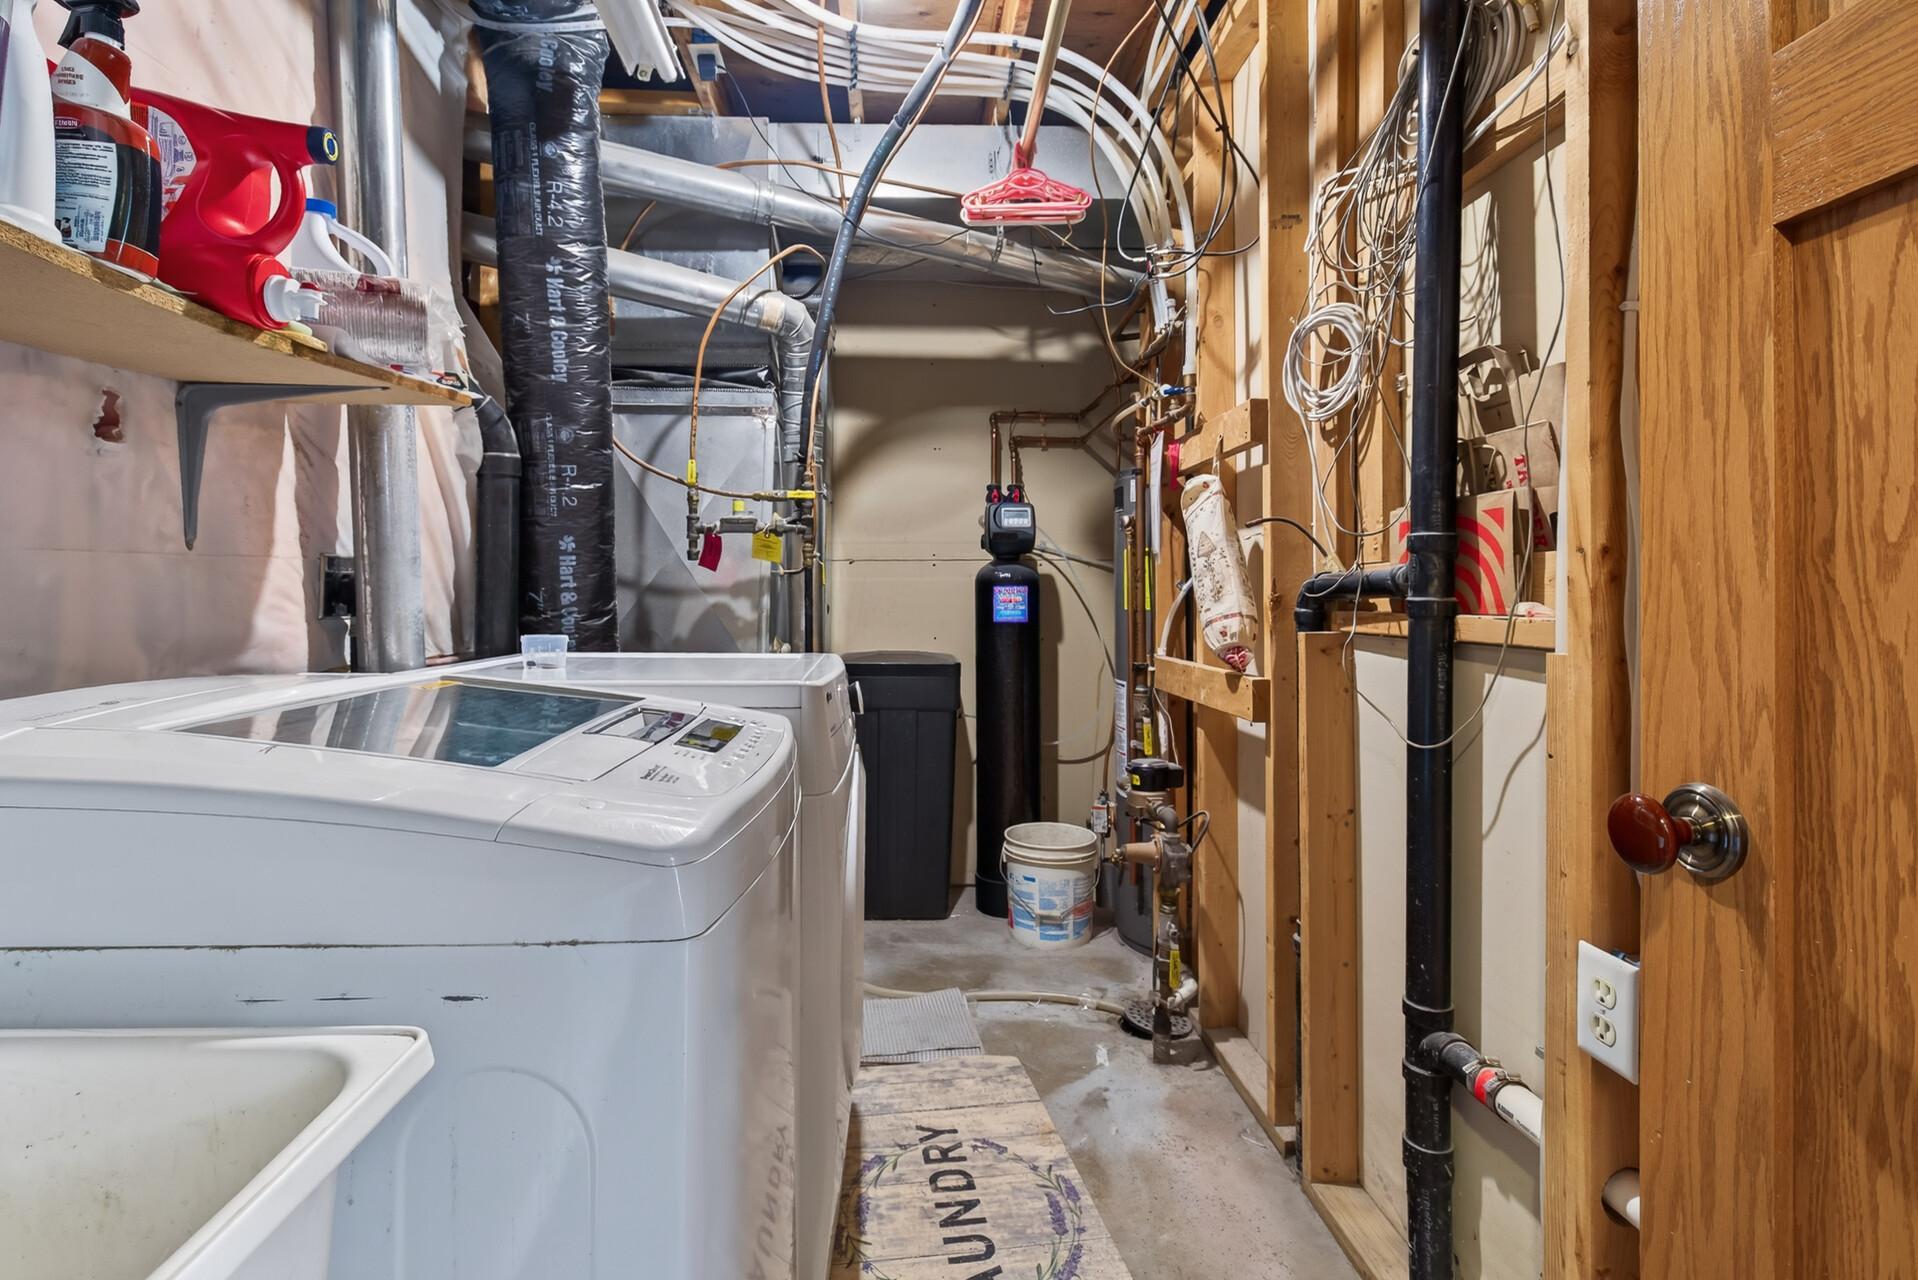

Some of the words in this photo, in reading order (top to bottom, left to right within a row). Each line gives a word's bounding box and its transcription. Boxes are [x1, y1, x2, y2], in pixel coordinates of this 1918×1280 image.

[547, 180, 564, 228] R-4.2
[547, 329, 569, 385] Cooley
[559, 555, 577, 589] Hart
[559, 591, 578, 606] &
